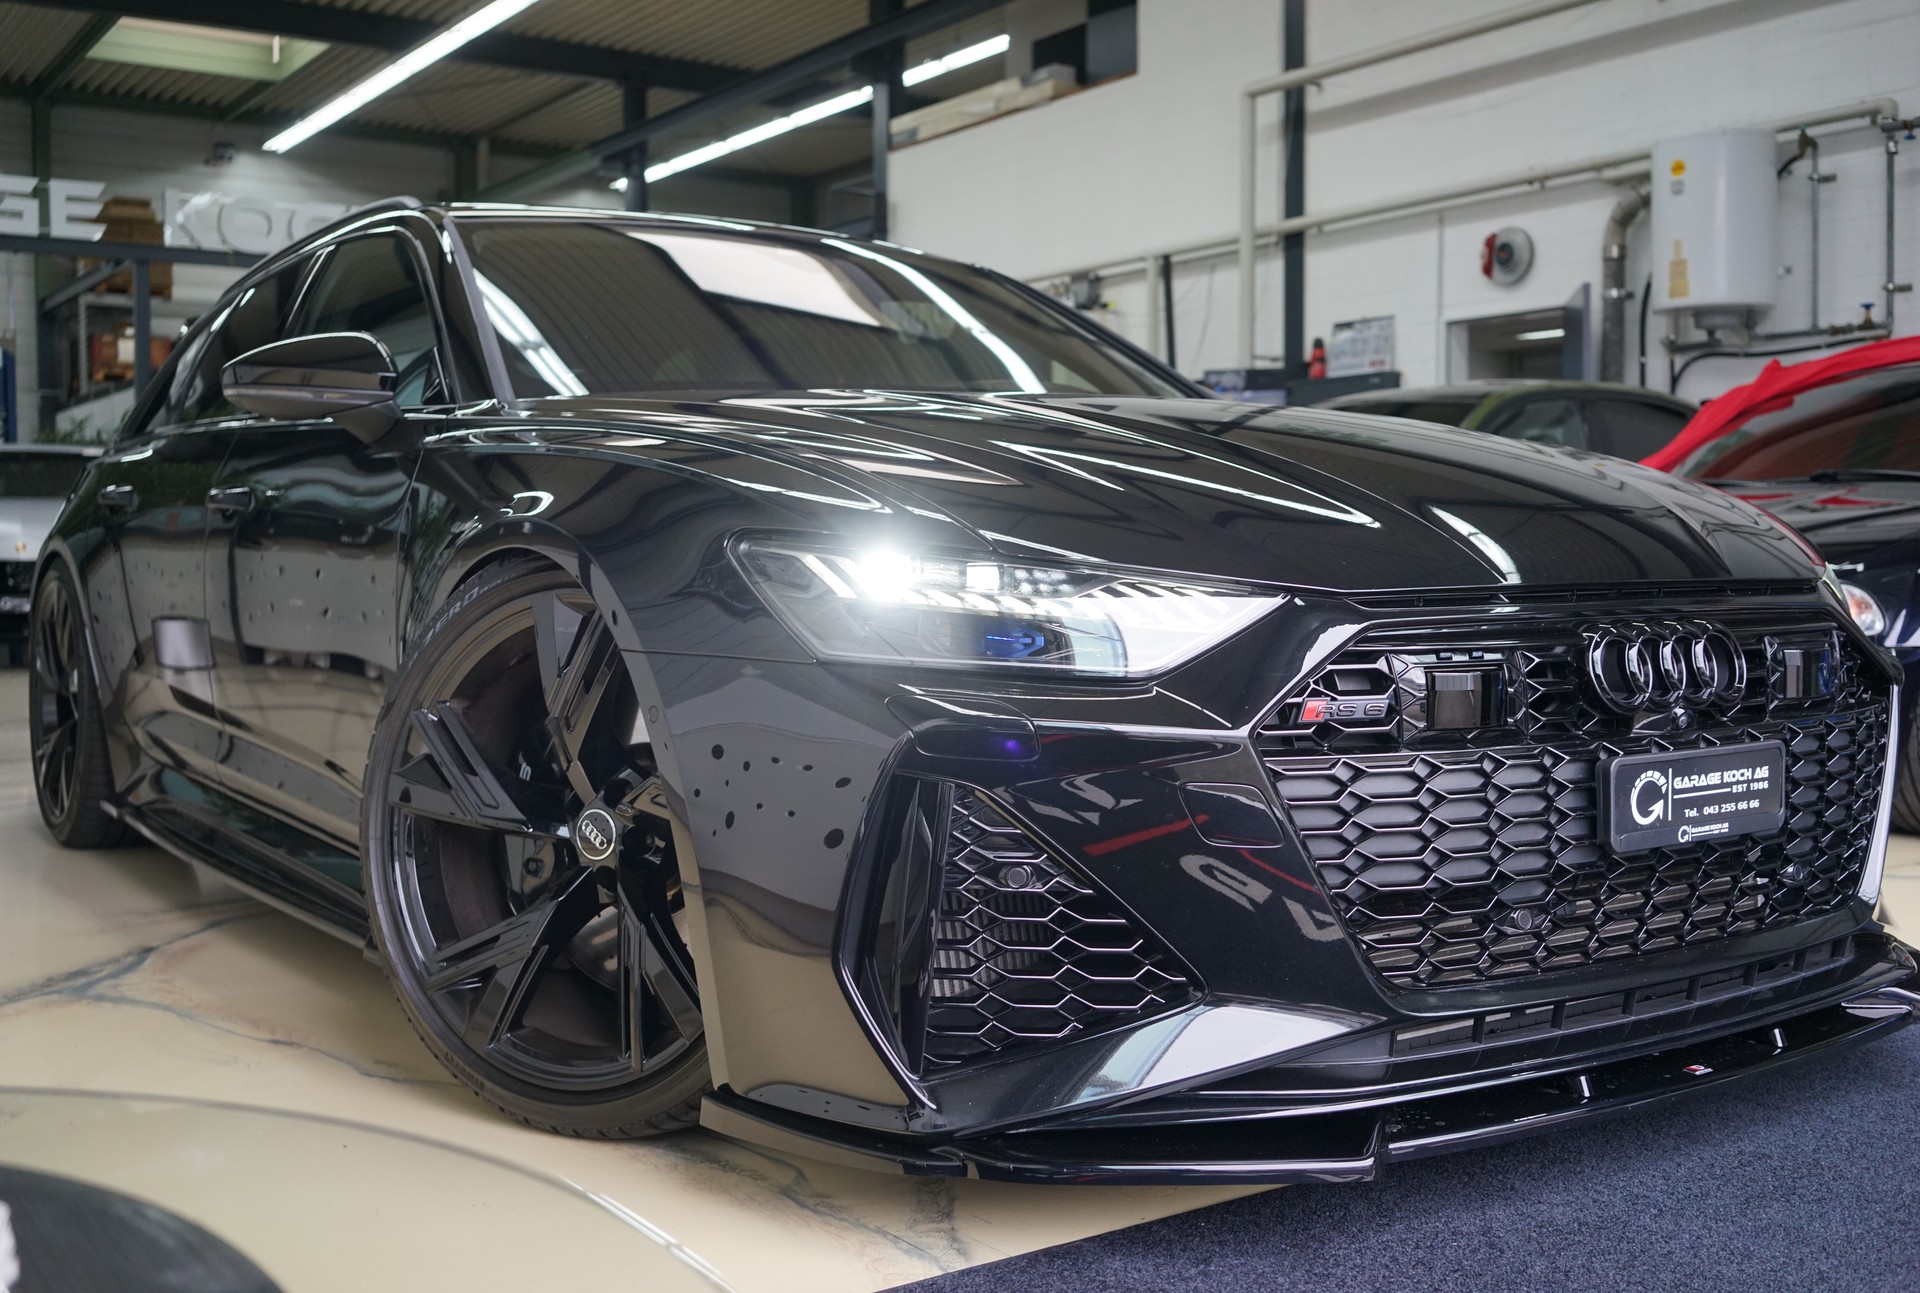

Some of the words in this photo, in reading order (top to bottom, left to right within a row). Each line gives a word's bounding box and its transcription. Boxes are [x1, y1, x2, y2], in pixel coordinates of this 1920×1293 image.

[1673, 772, 1722, 790] GARAGE
[1723, 768, 1752, 783] KOCH
[1753, 765, 1769, 779] AG
[1732, 783, 1748, 793] EST
[1749, 781, 1769, 791] 1986
[1684, 807, 1699, 818] Tel.
[1703, 805, 1719, 816] 043
[1720, 803, 1736, 813] 255
[1737, 800, 1748, 810] 66
[1749, 798, 1760, 808] 66
